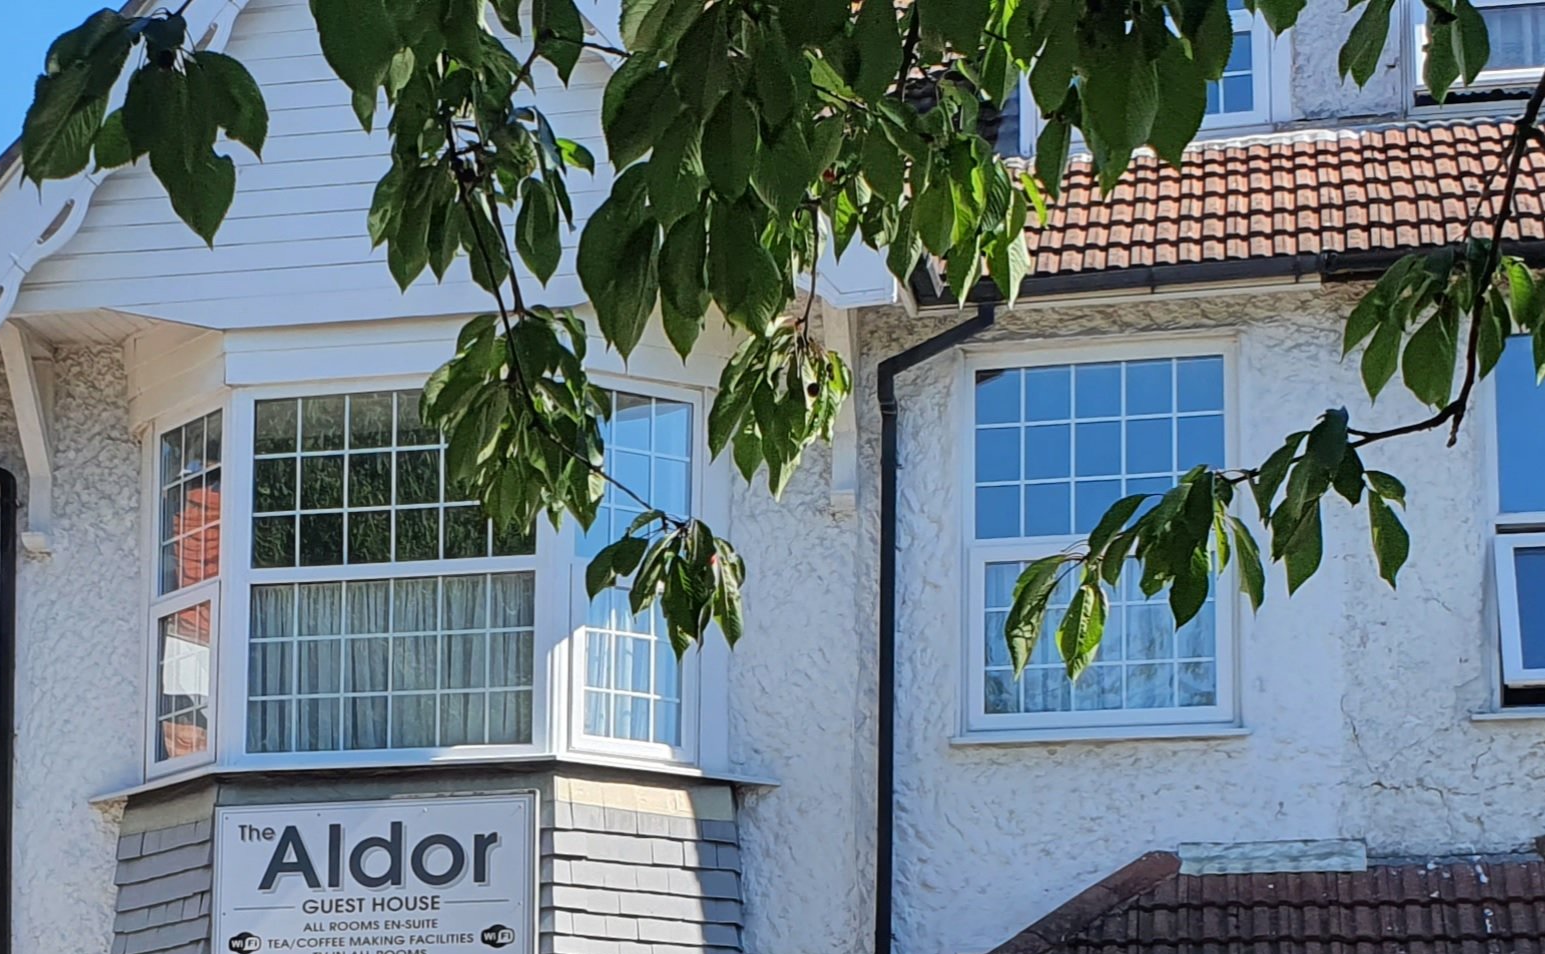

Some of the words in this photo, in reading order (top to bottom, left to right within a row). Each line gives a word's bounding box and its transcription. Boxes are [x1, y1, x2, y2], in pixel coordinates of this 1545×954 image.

[238, 824, 276, 842] The
[258, 821, 501, 891] Aldor
[302, 897, 365, 914] GUEST
[372, 895, 441, 912] HOUSE
[303, 922, 325, 932] ALL
[329, 920, 380, 931] ROOMS
[384, 918, 439, 930] EN-SUITE
[267, 937, 345, 949] TEA/COFFEE
[349, 935, 405, 947] MAKING
[409, 932, 474, 945] FACILITIES
